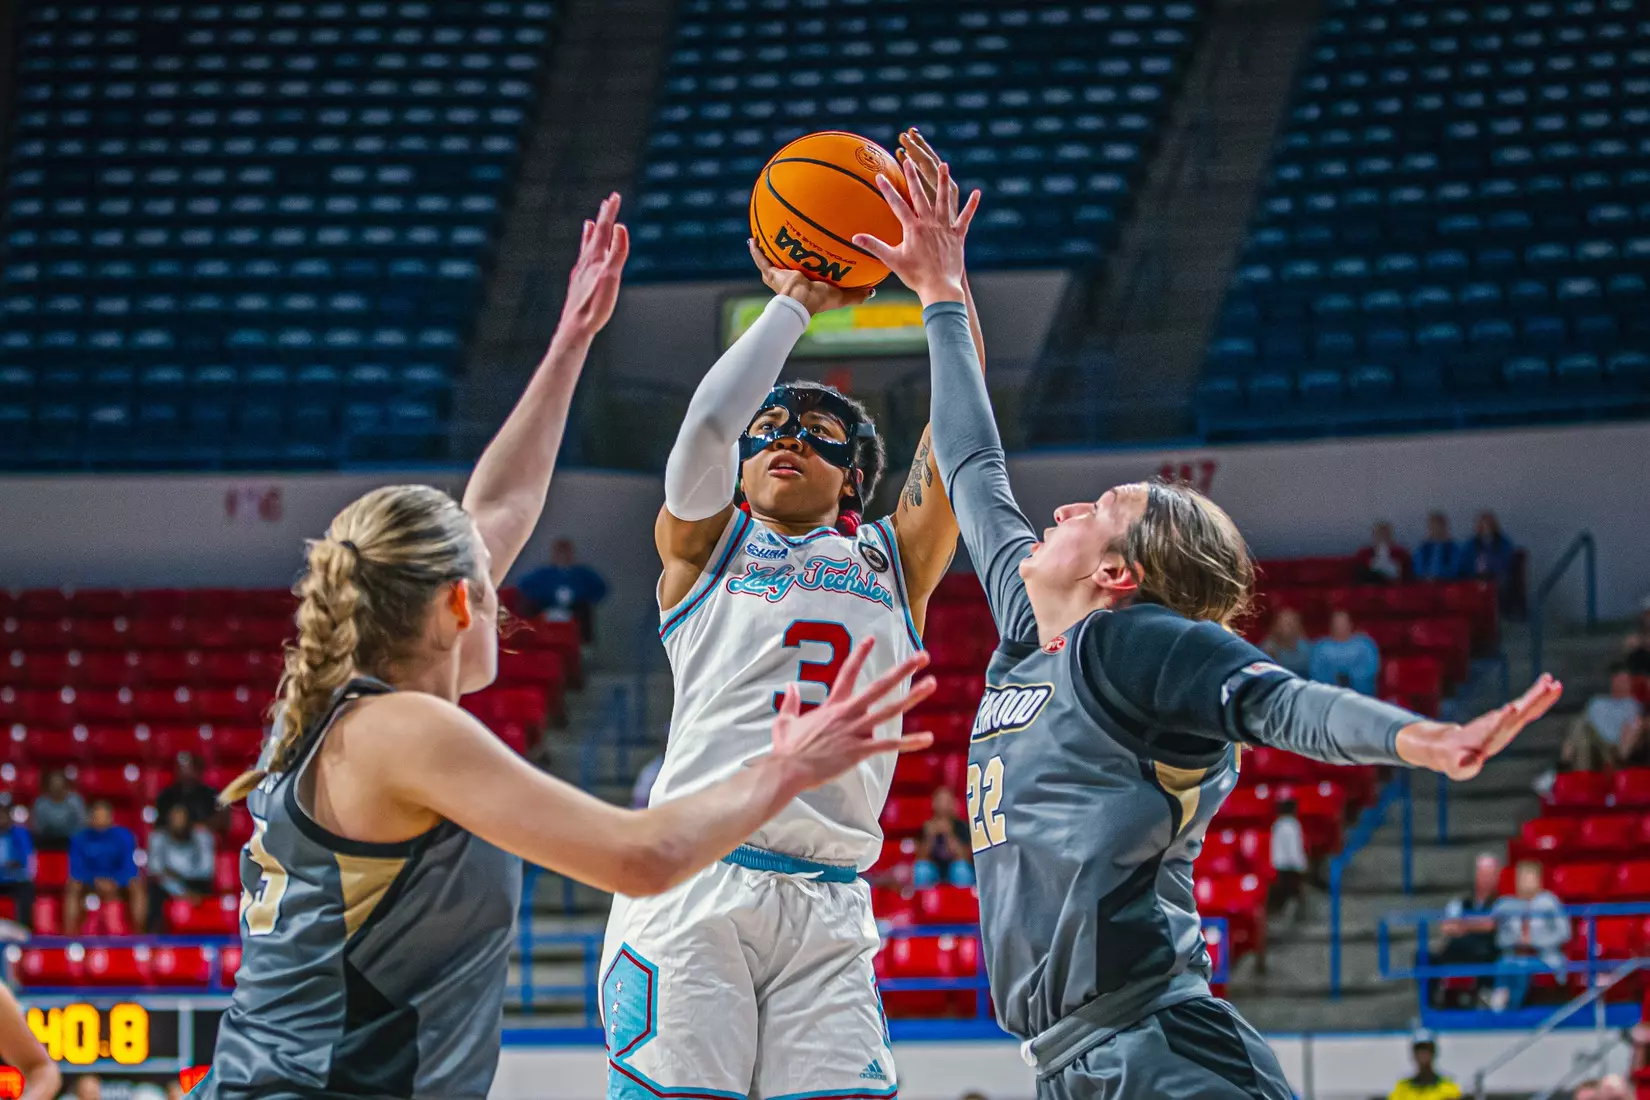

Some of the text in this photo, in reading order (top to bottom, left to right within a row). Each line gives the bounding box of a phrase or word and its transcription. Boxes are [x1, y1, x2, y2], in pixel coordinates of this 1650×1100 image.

[775, 226, 852, 282] NCAA
[726, 562, 795, 603] Lady
[772, 618, 853, 716] 3
[966, 755, 1008, 855] 22
[26, 1002, 150, 1065] 40.8
